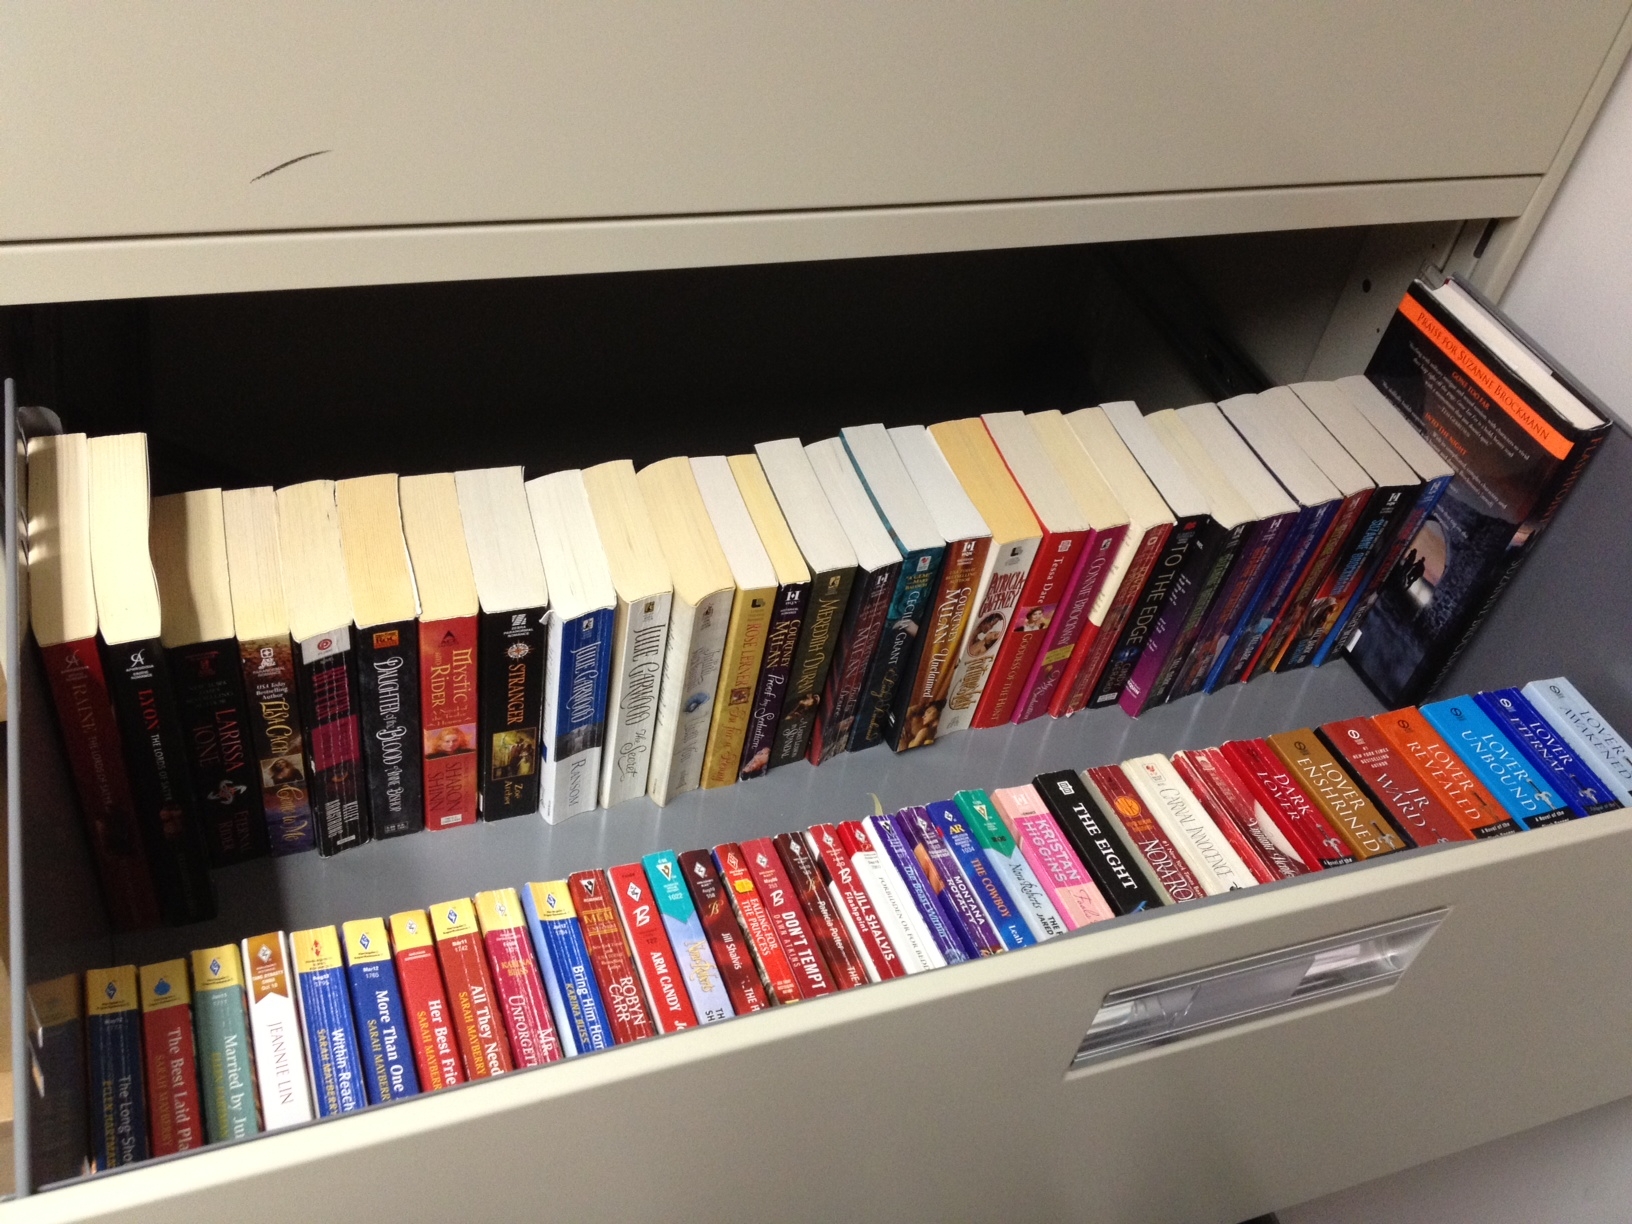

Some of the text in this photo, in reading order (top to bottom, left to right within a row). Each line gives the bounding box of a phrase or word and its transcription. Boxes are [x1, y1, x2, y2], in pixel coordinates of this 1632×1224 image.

[1417, 312, 1550, 440] PRAISE FOR SUZANNE BROCKMANN
[1451, 371, 1480, 401] GONE TOO
[1038, 556, 1063, 604] Tessa Dare
[1058, 556, 1106, 645] CONNIE BROCKWAY
[1126, 543, 1189, 647] TO THE EDGE
[899, 590, 921, 637] CECILIA
[933, 590, 960, 644] MILAN
[949, 586, 971, 642] COURTNEY
[735, 623, 761, 688] ROSE LERNER
[767, 621, 788, 669] MILAN
[781, 619, 801, 667] COURTNEY
[797, 598, 840, 695] MEREDITH DURAN
[847, 627, 869, 678] MILAN
[888, 632, 908, 665] GRANT
[1011, 633, 1033, 673] GODDESS
[256, 686, 289, 696] Bestselling
[262, 692, 284, 700] Author
[271, 681, 286, 689] Today
[507, 663, 526, 725] STRANGER
[566, 641, 601, 724] JULIE GARWOOD
[619, 623, 666, 726] JULIE GARWOOD
[923, 648, 948, 698] Unclaimed
[1103, 659, 1124, 693] GERARD
[1114, 663, 1131, 688] CINDY
[72, 682, 97, 734] RAINE
[138, 689, 159, 730] LYON
[374, 656, 407, 765] DAUGHTER BLOOD
[752, 674, 785, 751] Proof Seduction
[150, 733, 166, 771] THE LORDS
[193, 725, 220, 768] IONE
[215, 708, 245, 773] LARISSA
[634, 728, 647, 746] The
[1352, 747, 1390, 760] NEW YORK TIMES
[1482, 733, 1528, 780] LOVER
[1510, 717, 1564, 773] ETERNAL
[1530, 722, 1573, 765] LOVER
[1560, 706, 1632, 780] AWAKENED
[1580, 710, 1627, 758] LOVER
[569, 758, 587, 808] RANSOM
[617, 742, 647, 783] Secret
[1360, 754, 1390, 765] BESTSELLING
[1371, 761, 1389, 769] AUTHOR
[1407, 741, 1482, 820] REVEALED
[1428, 743, 1475, 791] LOVER
[1461, 730, 1537, 811] UNBOUND
[428, 773, 445, 812] SHINN
[446, 761, 464, 812] SHARON
[504, 780, 513, 805] Archer
[1257, 771, 1300, 821] LOVER
[1274, 773, 1313, 816] DARK
[1297, 757, 1381, 852] ENSHRINED
[1320, 762, 1365, 811] LOVER
[1376, 773, 1426, 828] WARD
[276, 784, 308, 842] Come Me
[325, 798, 344, 839] ARMSTRONG
[342, 800, 359, 823] KELLEY
[1159, 788, 1236, 879] CARNAL INNOCENCE
[1485, 825, 1497, 833] Novel
[1539, 814, 1551, 822] Novel
[1035, 819, 1082, 882] KRISTAN
[1072, 803, 1139, 891] THE EIGHT
[1139, 838, 1177, 879] NORA
[1166, 847, 1195, 886] New York Times
[947, 879, 976, 926] ROYALTY
[954, 876, 986, 925] MONTANA
[971, 858, 1012, 918] THE COWBOY
[1009, 863, 1043, 909] Nora Roberts
[741, 900, 772, 957] THE PRINCESS
[750, 897, 778, 951] FALLING FOR
[818, 900, 832, 930] Patricia
[844, 892, 869, 933] Flashpoint
[852, 890, 896, 962] JILL SHALVIS
[879, 877, 919, 948] FORBIDDEN OR FOR
[1008, 924, 1024, 945] Leah
[1036, 912, 1054, 936] JARED
[1047, 916, 1059, 931] THE
[721, 932, 743, 971] Jill Shalvis
[773, 914, 788, 937] DAWN
[783, 938, 801, 968] ATKINS
[782, 911, 808, 947] DON'T
[798, 948, 827, 990] TEMPT
[572, 965, 597, 1023] Bring Him
[650, 951, 682, 1012] ARM CANDY
[744, 983, 757, 1003] THE
[846, 965, 859, 983] THE
[565, 983, 589, 1044] KARINA BLISS
[608, 984, 631, 1023] CARR
[620, 976, 646, 1026] ROBYN
[705, 1010, 716, 1022] SH
[715, 1007, 726, 1020] TH
[317, 1028, 330, 1062] SARAH
[367, 1019, 381, 1052] SARAH
[375, 989, 404, 1093] More Than One
[417, 1011, 430, 1042] SARAH
[428, 999, 457, 1086] Her Best Frie
[459, 991, 487, 1076] SARAH MAYBERRY
[470, 985, 505, 1077] All They Need
[118, 1075, 132, 1097] The
[154, 1054, 166, 1088] SARAH
[168, 1026, 190, 1124] The Best Laid
[224, 1034, 245, 1112] Married by
[267, 1021, 295, 1106] JEANNIE LIN
[331, 1027, 354, 1112] Within Reach
